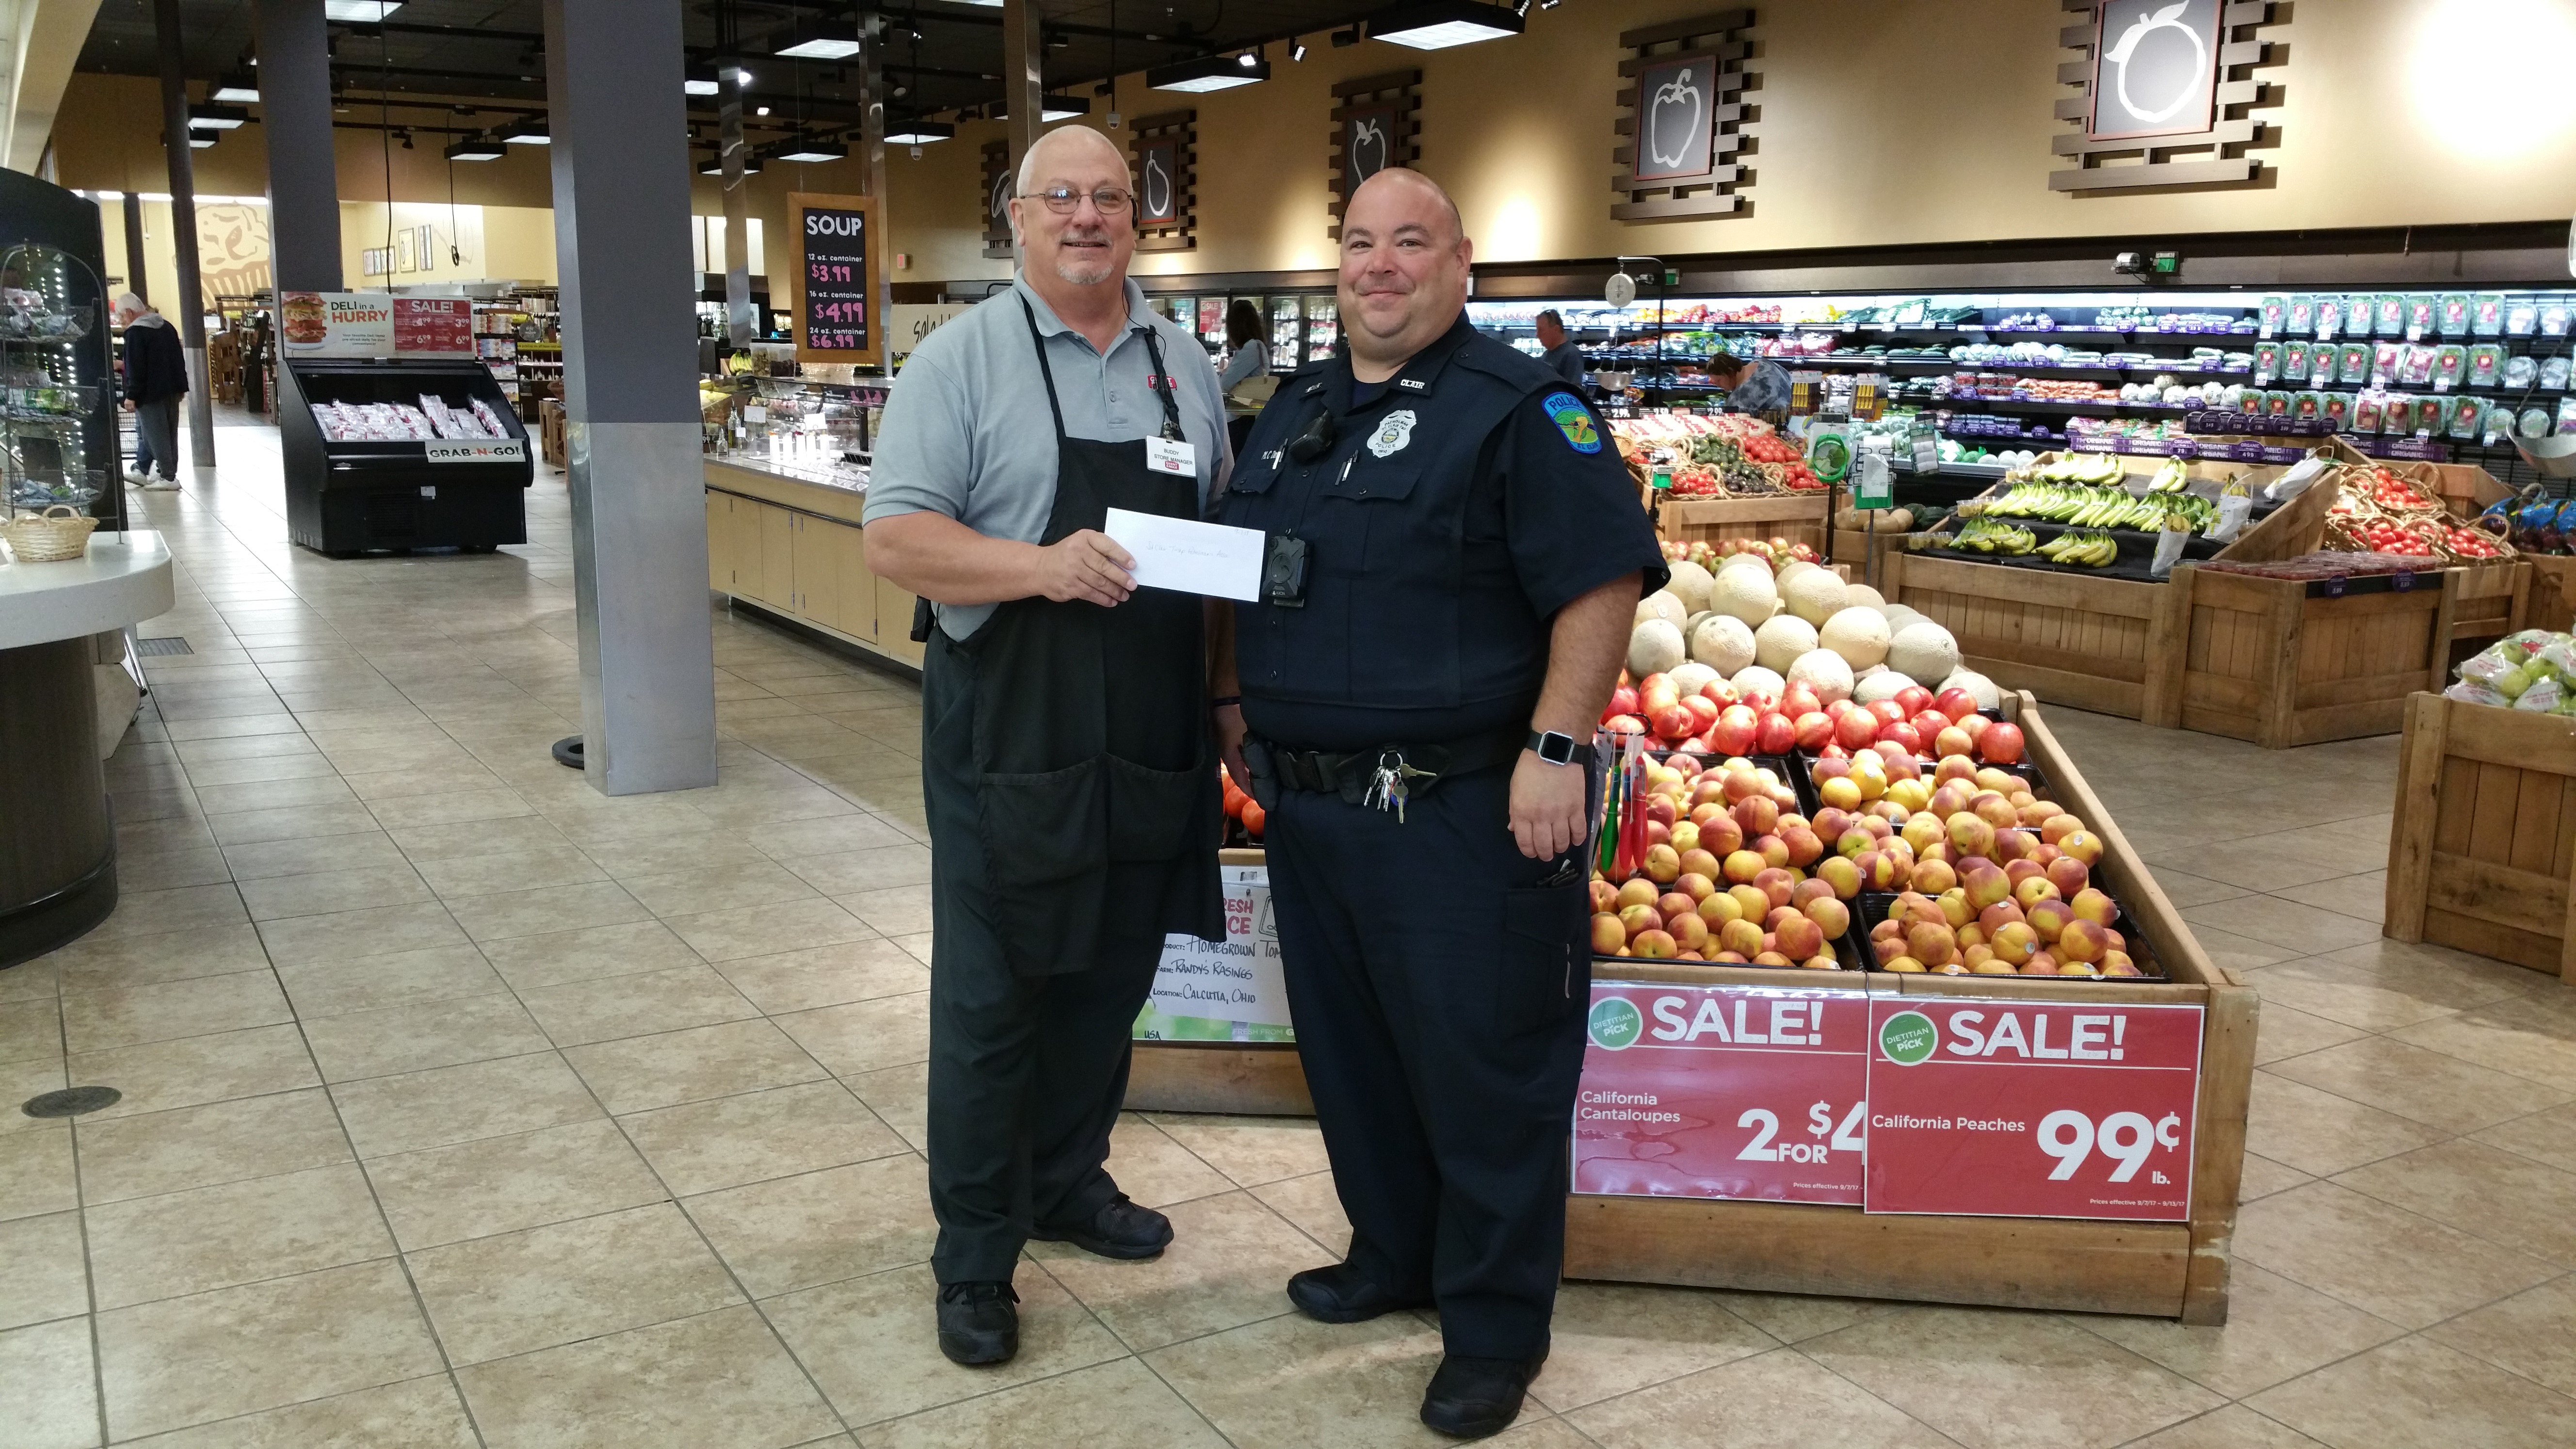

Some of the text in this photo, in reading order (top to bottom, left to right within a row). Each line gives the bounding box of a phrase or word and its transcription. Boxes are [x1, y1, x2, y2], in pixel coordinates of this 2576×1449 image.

[806, 215, 862, 236] SOUP
[811, 263, 851, 282] $3.99
[331, 301, 357, 310] DELI
[412, 300, 454, 313] SALE!
[815, 302, 863, 323] $4.99
[332, 310, 388, 323] HURRY
[811, 334, 854, 348] $6.99
[1400, 378, 1426, 389] CLAIR
[1547, 396, 1583, 411] POLICE
[429, 446, 520, 457] GRAB-N-GO!
[1170, 457, 1193, 466] MANAGER
[1187, 935, 1256, 957] HOMEGROWN
[1213, 961, 1253, 980] RASINGS
[1153, 987, 1182, 998] LOCATION:
[1232, 988, 1256, 1003] OHIO
[1593, 1012, 1634, 1030] DIETITIAN
[1650, 996, 1824, 1046] SALE!
[1144, 1030, 1161, 1041] USA
[1885, 1027, 1930, 1045] DIETITIAN
[1946, 1010, 2127, 1061] SALE!
[1580, 1091, 1658, 1106] California
[1580, 1107, 1681, 1124] Cantaloupes
[1871, 1114, 1952, 1130] California
[1956, 1117, 2026, 1132] Peaches
[1735, 1108, 1779, 1162] 2
[1778, 1143, 1828, 1164] FOR
[2152, 1171, 2171, 1185] lb.
